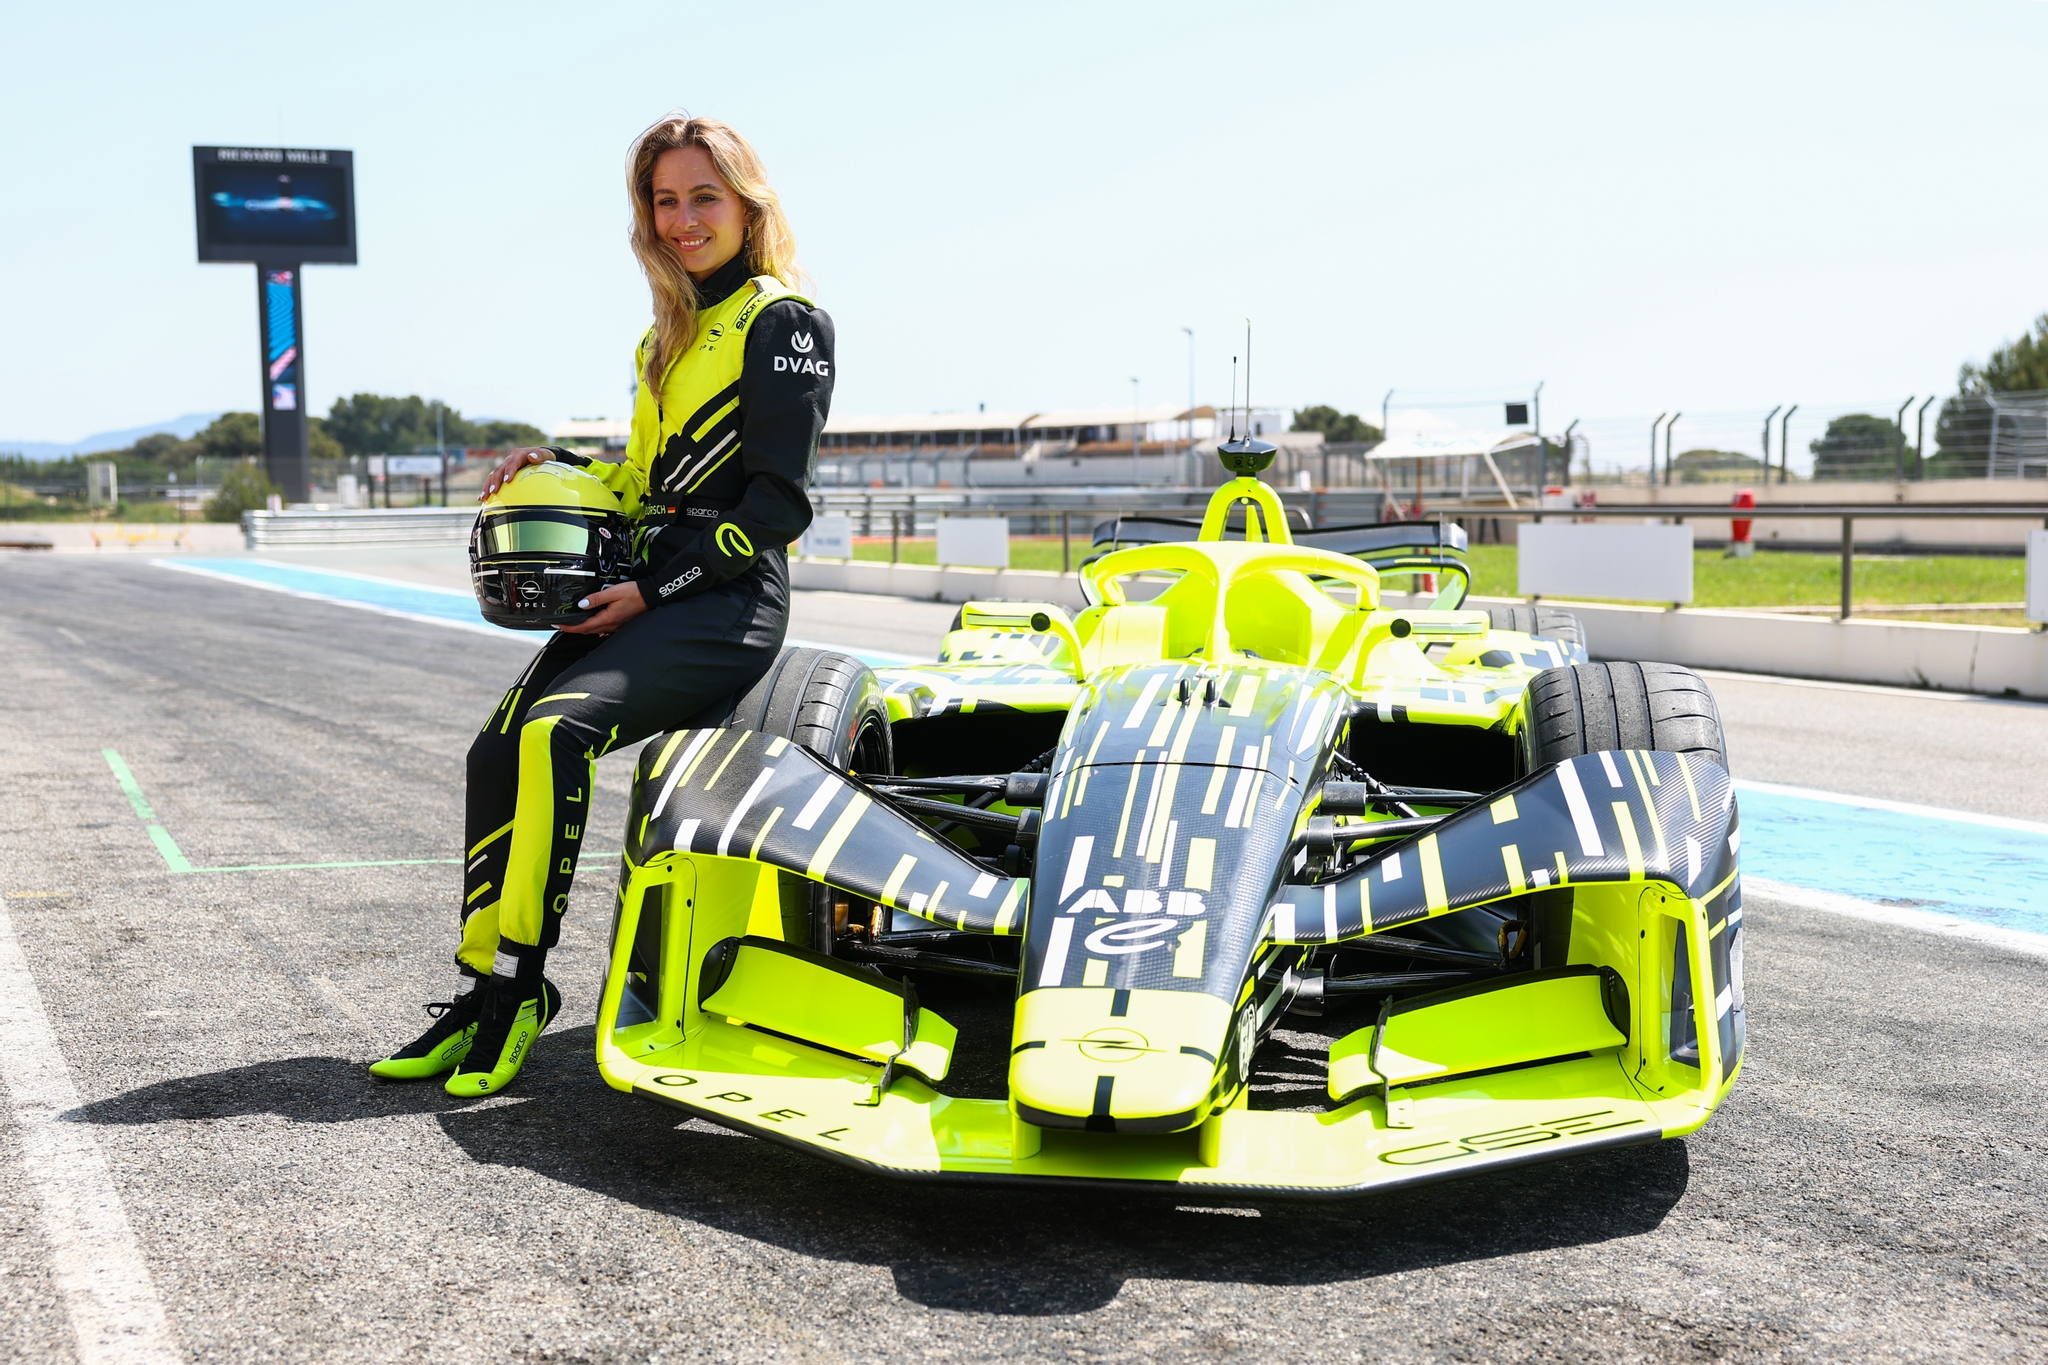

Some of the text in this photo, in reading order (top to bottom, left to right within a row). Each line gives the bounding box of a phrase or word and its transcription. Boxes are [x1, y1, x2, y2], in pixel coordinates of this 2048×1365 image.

[735, 292, 773, 332] sparco
[773, 355, 829, 377] DVAG
[686, 507, 719, 518] sparco
[658, 566, 703, 598] sparco
[552, 787, 583, 914] OPEL
[1065, 888, 1207, 916] ABB
[508, 1030, 529, 1066] sparco
[652, 1074, 851, 1142] OPEL
